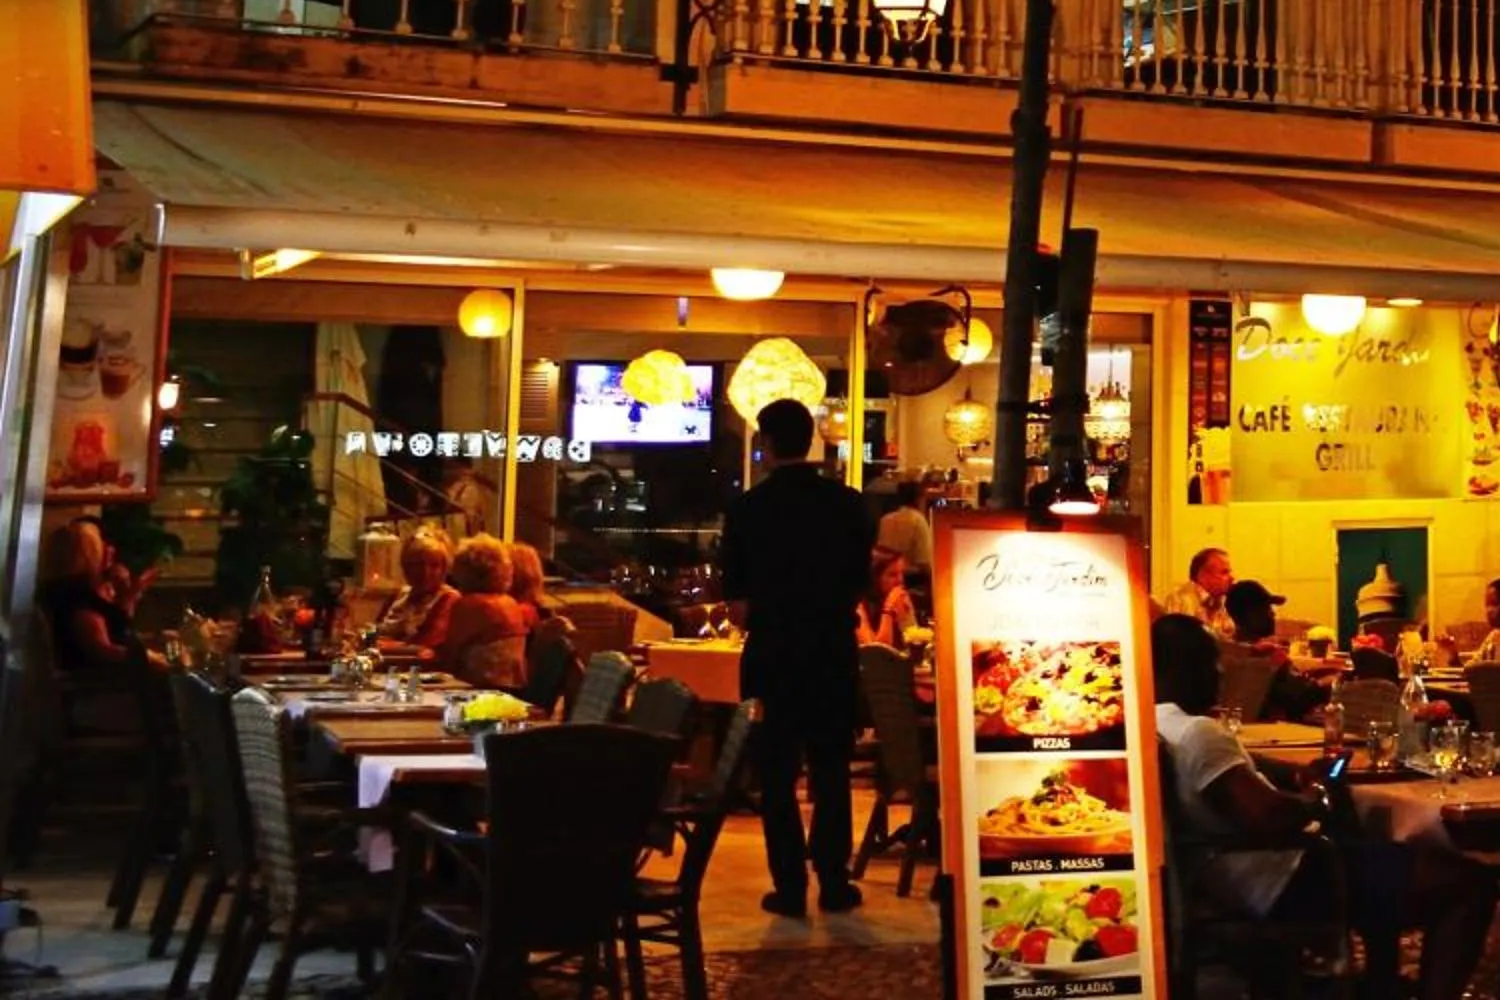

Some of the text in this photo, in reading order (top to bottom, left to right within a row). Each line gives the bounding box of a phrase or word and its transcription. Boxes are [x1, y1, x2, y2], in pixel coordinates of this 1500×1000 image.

[1033, 737, 1071, 750] PIZZAS
[1010, 857, 1105, 873] PASTAS MASSAS
[1013, 981, 1116, 999] SALADS SALADAS
